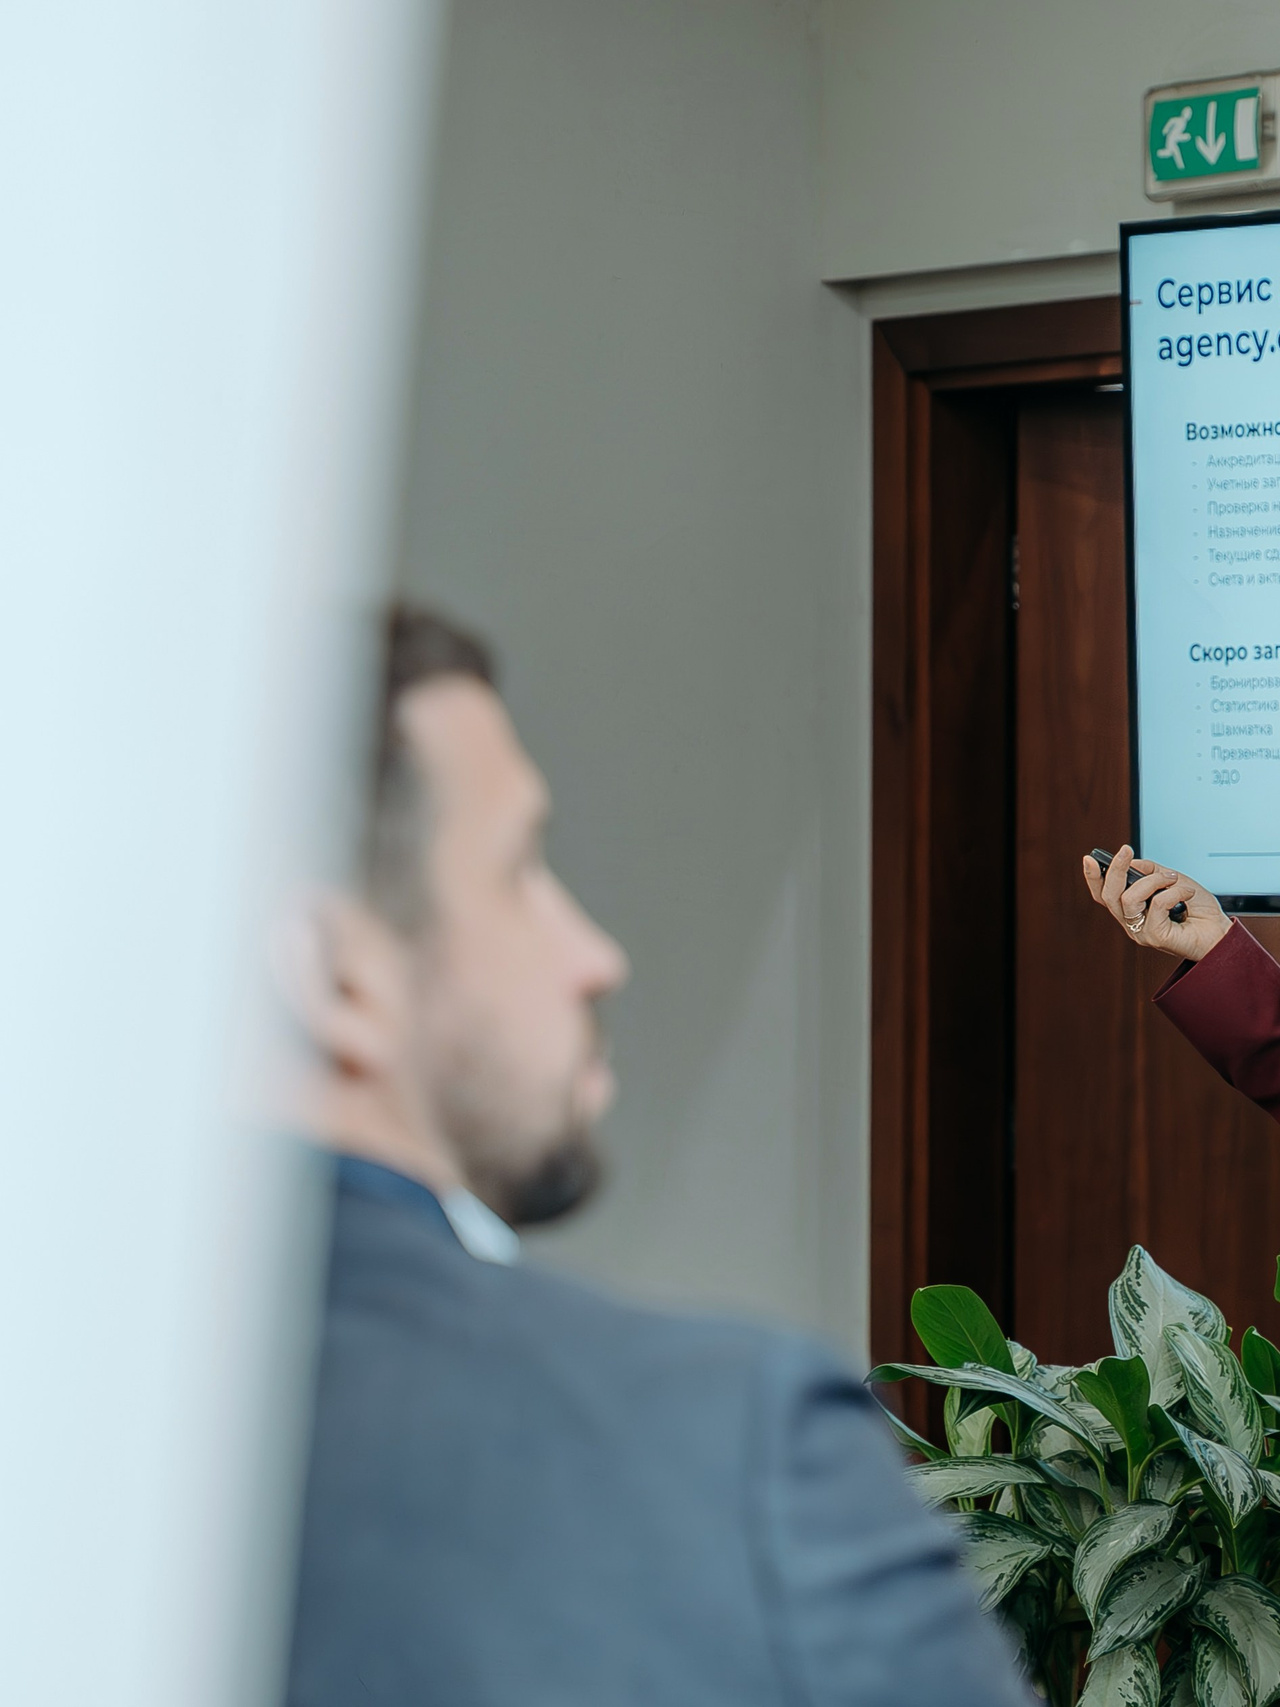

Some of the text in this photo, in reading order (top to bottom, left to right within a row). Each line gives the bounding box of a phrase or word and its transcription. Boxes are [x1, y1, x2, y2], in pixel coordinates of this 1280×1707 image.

[1158, 278, 1272, 315] Сервис
[1206, 477, 1260, 492] Учетные
[1206, 500, 1270, 517] Проверка
[1207, 547, 1263, 566] Текущие
[1207, 571, 1245, 588] Счета
[1189, 643, 1248, 666] Скоро
[1210, 698, 1280, 714] Статистика
